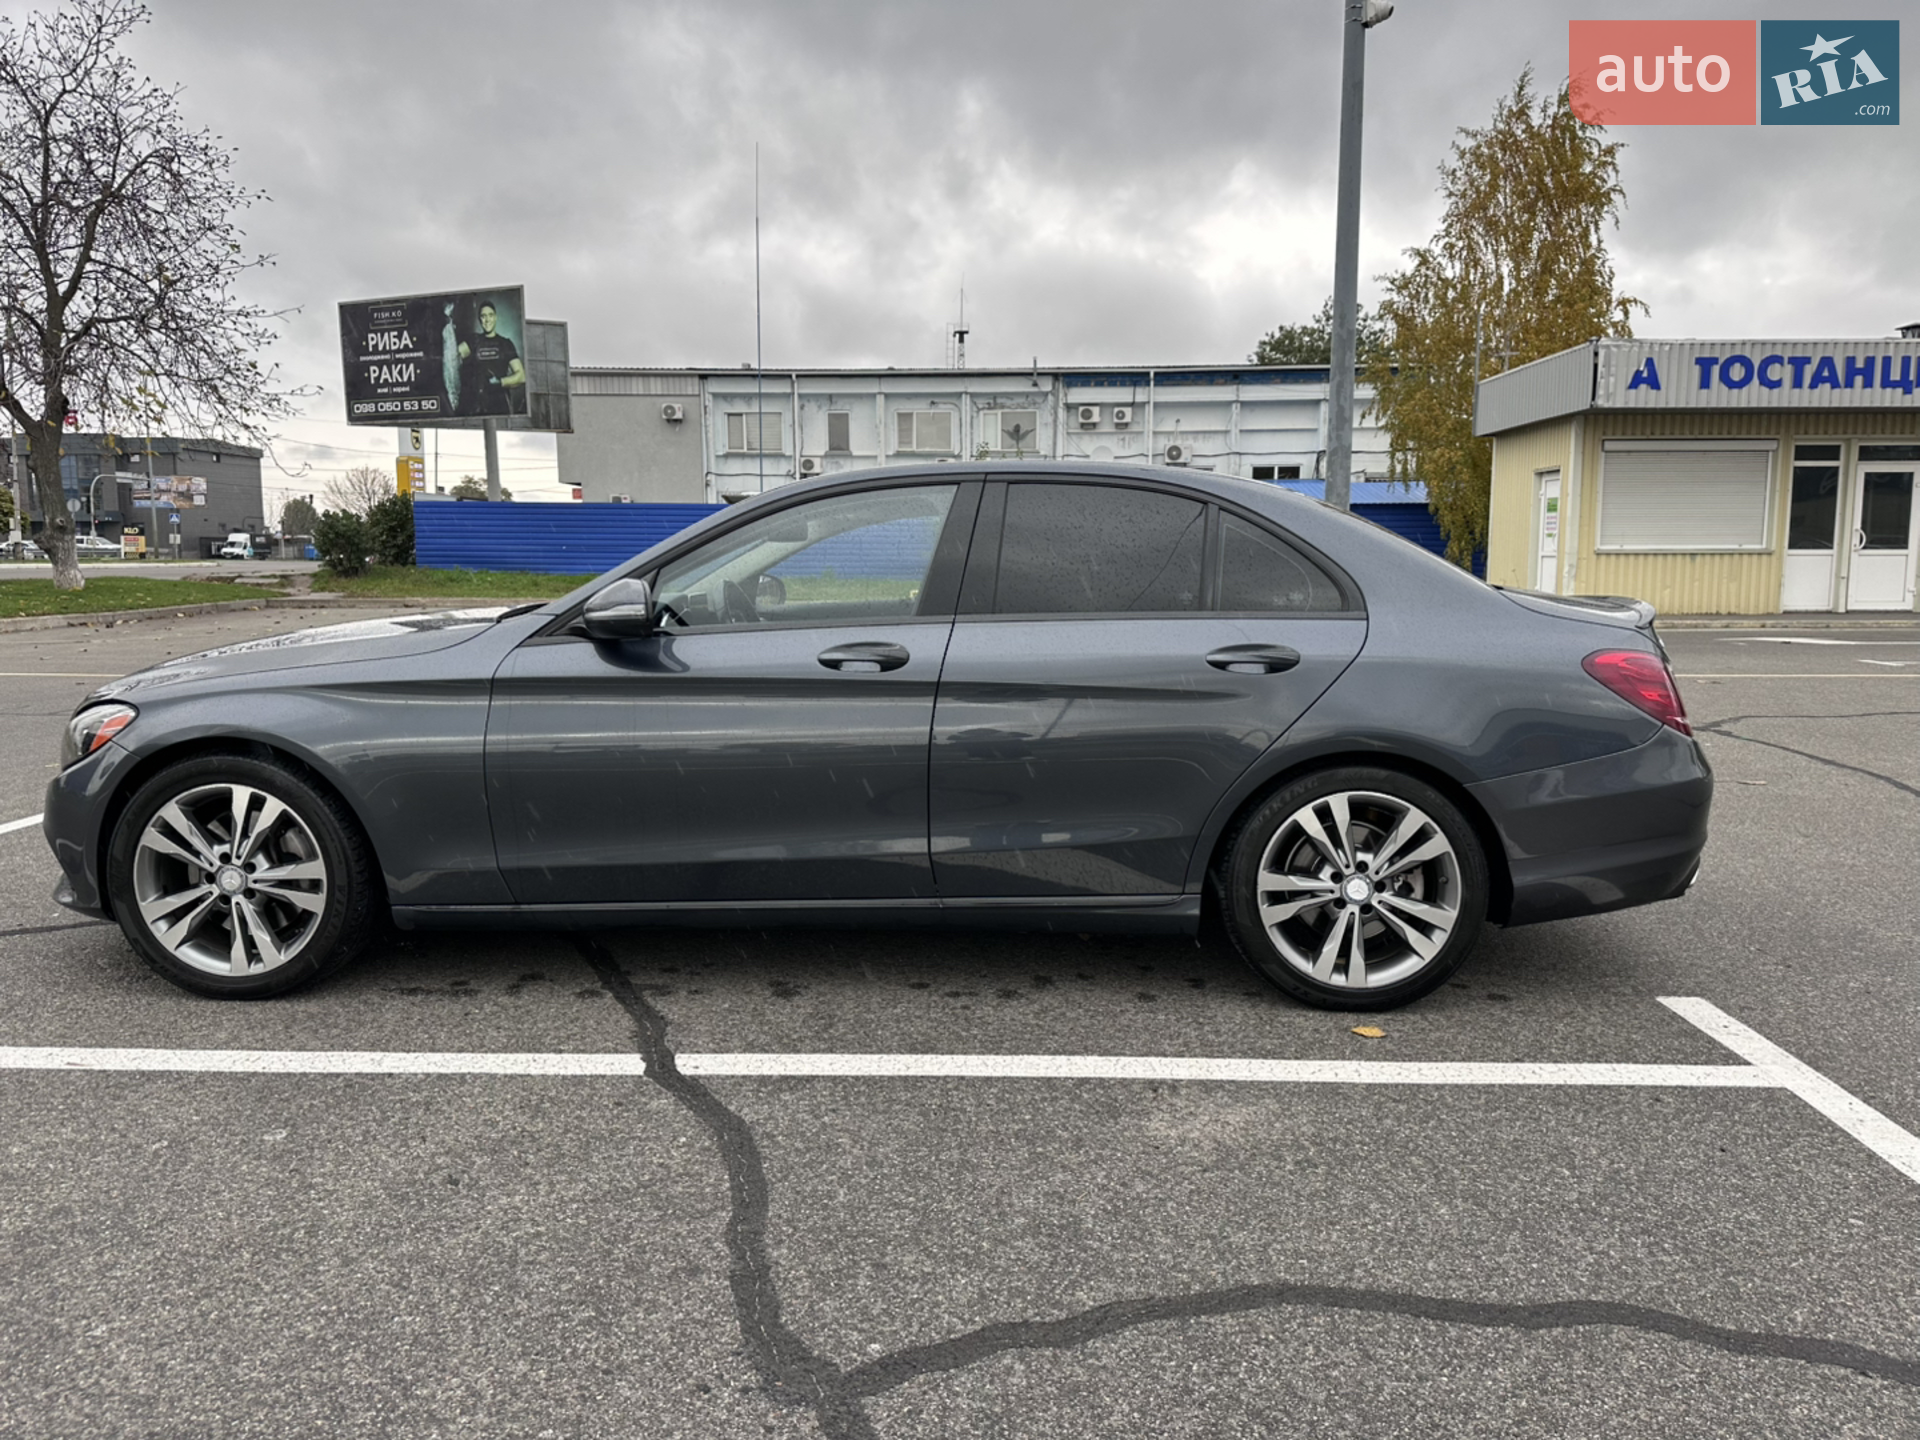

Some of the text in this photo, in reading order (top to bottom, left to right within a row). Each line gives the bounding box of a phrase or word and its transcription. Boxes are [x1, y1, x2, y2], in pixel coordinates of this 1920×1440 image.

[367, 330, 413, 352] РИБА
[369, 363, 415, 385] РАКИ
[1627, 354, 1920, 395] А ТОСТАНЦ
[353, 399, 437, 413] 098 050 53 50
